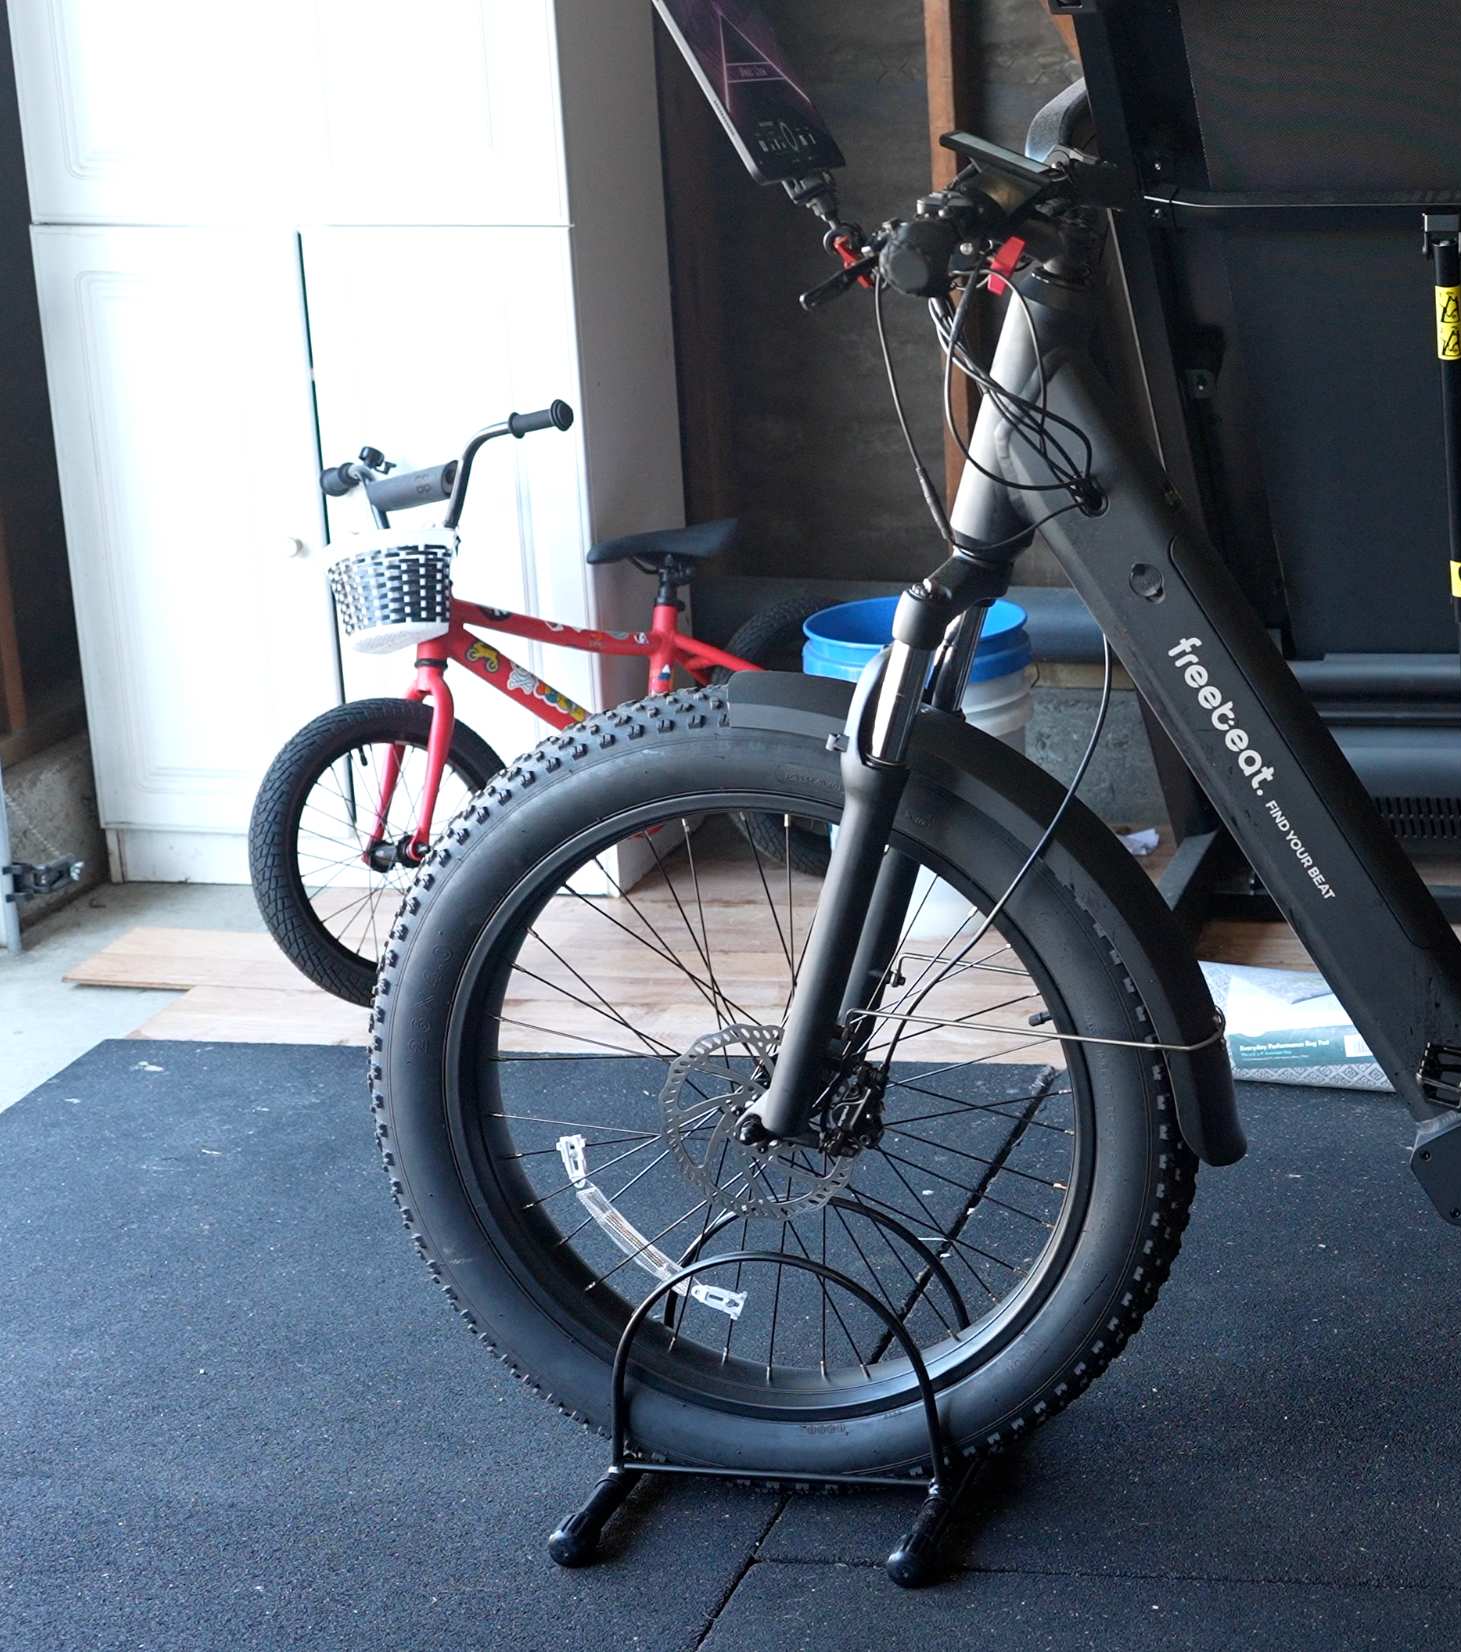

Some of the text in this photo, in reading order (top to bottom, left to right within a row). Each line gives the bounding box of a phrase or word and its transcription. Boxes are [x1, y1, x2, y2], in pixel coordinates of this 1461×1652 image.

[1265, 800, 1336, 901] FIND YOUR BEAT
